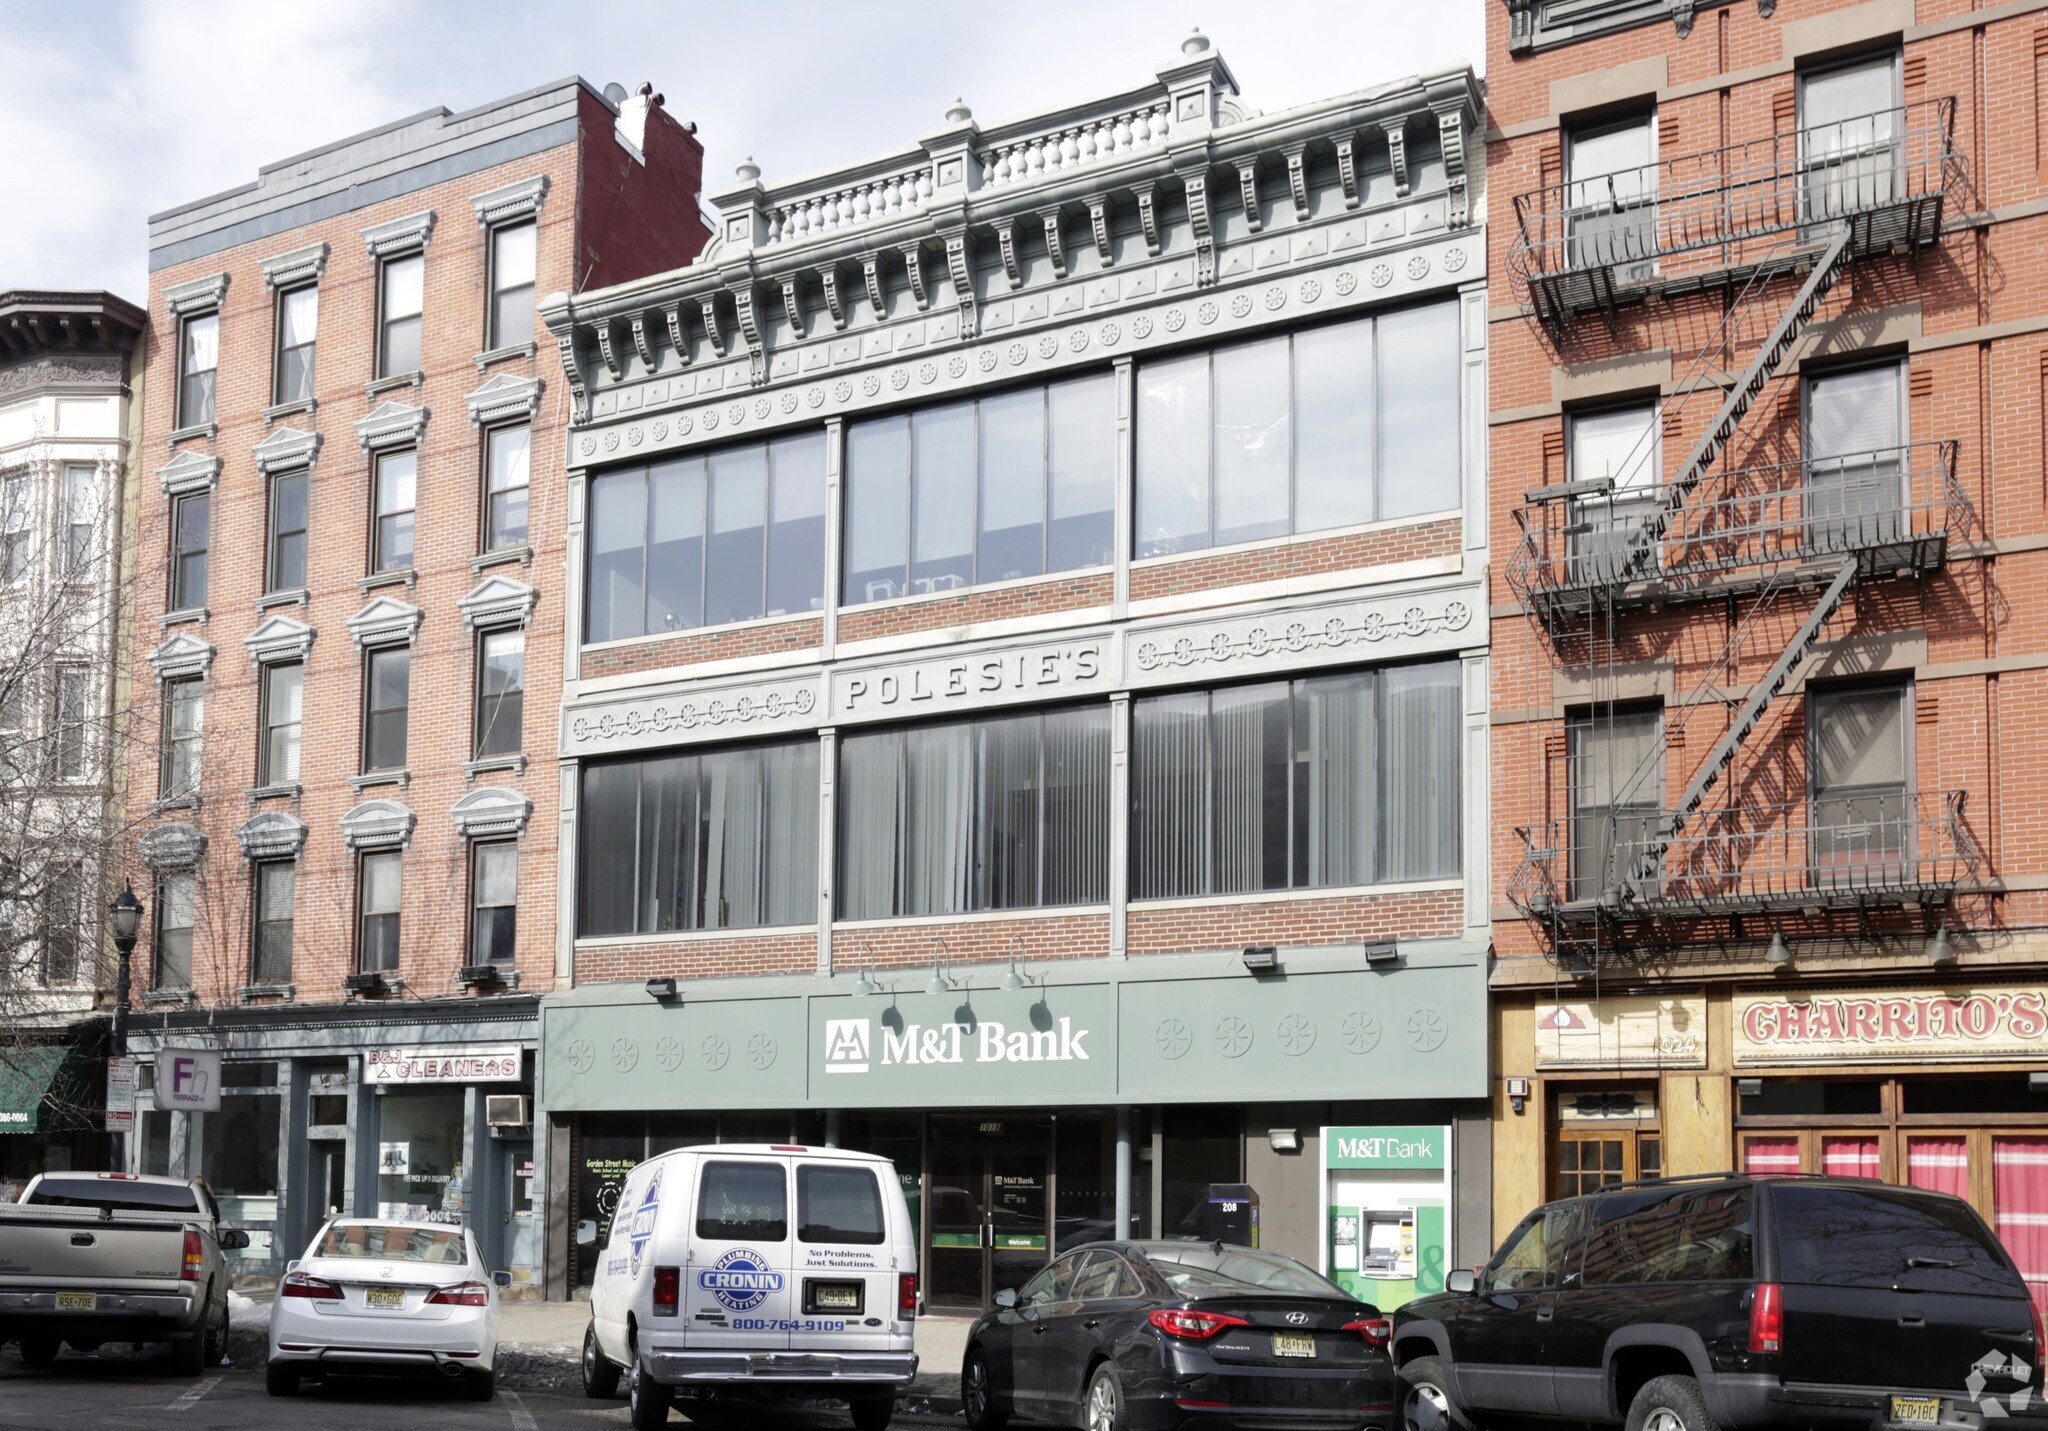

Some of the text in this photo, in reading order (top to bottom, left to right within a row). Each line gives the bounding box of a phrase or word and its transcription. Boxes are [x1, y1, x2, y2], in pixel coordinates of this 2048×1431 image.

[846, 646, 1100, 709] POLESIE'S
[1744, 992, 2046, 1045] CHARRITO'S
[880, 1017, 1090, 1064] M&T Bank
[109, 1058, 119, 1067] NO
[368, 1050, 401, 1065] B&J
[396, 1059, 516, 1078] CLEANERS
[1337, 1137, 1433, 1158] M&T Bank
[586, 1159, 604, 1168] Garden
[605, 1159, 621, 1168] Street
[431, 1174, 451, 1183] DELIVERY
[1222, 1202, 1237, 1212] 208
[1008, 1238, 1031, 1246] Welcome
[717, 1250, 767, 1272] PLUMBING
[809, 1249, 874, 1259] No Problems.
[805, 1259, 877, 1269] Just Solutions.
[703, 1273, 780, 1290] CRONIN
[717, 1291, 765, 1311] HEATING
[732, 1319, 845, 1331] 800-764-9109
[1971, 1363, 2032, 1376] CHEVROLET
